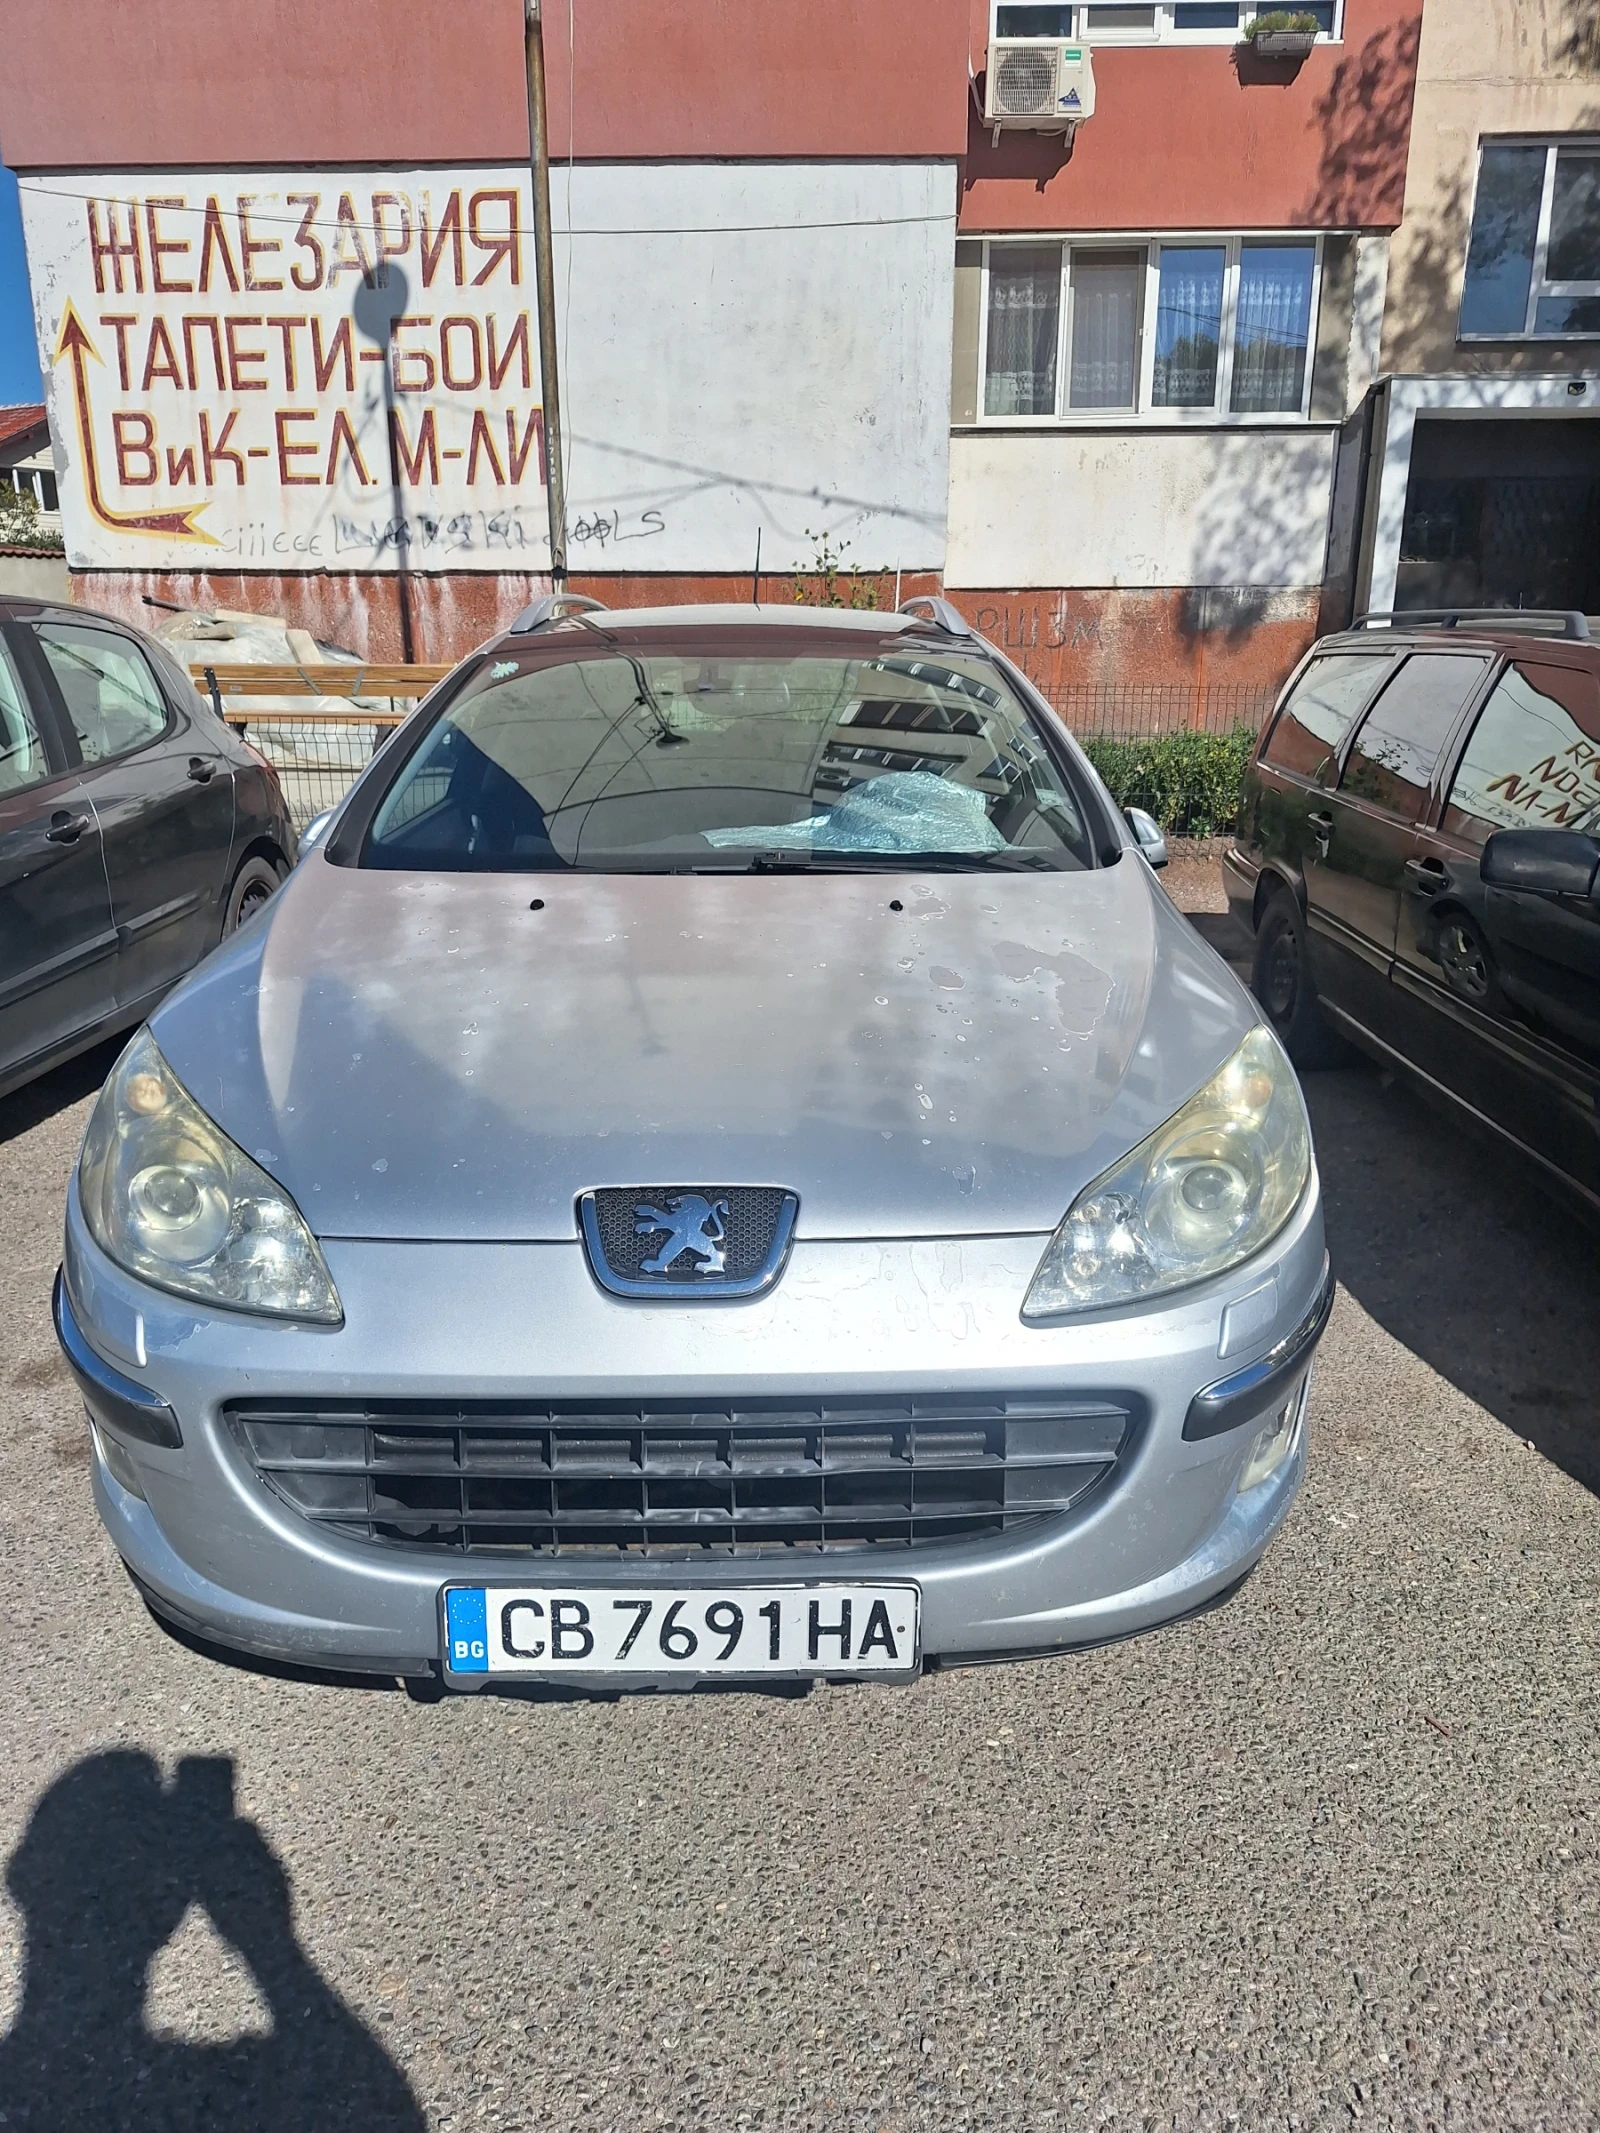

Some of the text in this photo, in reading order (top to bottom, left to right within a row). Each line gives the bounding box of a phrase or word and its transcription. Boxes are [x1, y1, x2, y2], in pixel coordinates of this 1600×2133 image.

[87, 189, 521, 293] ЖЕЛЕЗАРИЯ
[100, 310, 531, 392] ТАПЕТИ-БОИ
[387, 405, 547, 486] М-ЛИ
[455, 1640, 484, 1659] BG
[501, 1598, 898, 1660] CB 7691 HA
